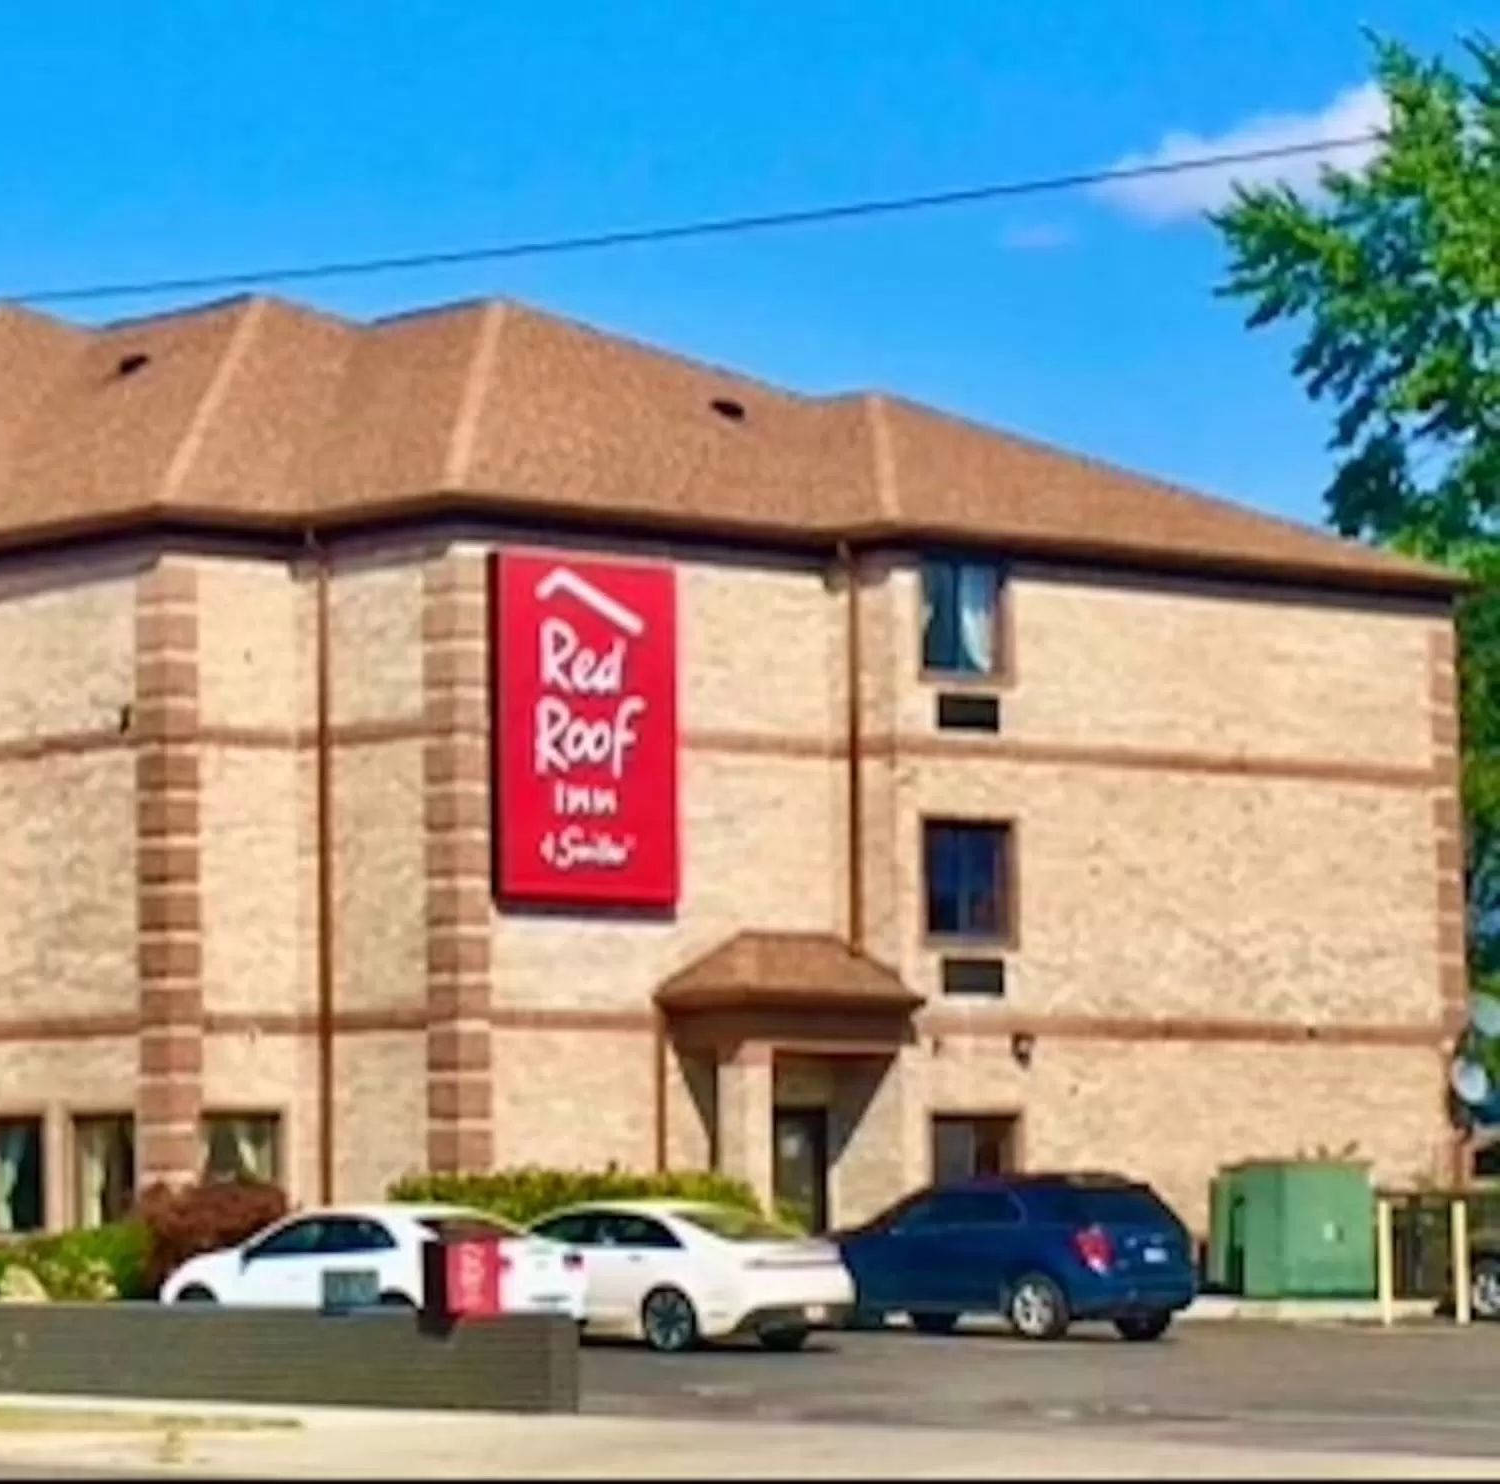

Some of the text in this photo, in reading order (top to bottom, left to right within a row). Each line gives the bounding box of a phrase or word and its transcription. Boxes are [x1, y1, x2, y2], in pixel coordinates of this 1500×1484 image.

[540, 616, 626, 692] Red
[535, 696, 645, 778] Roof
[555, 780, 617, 814] Inn
